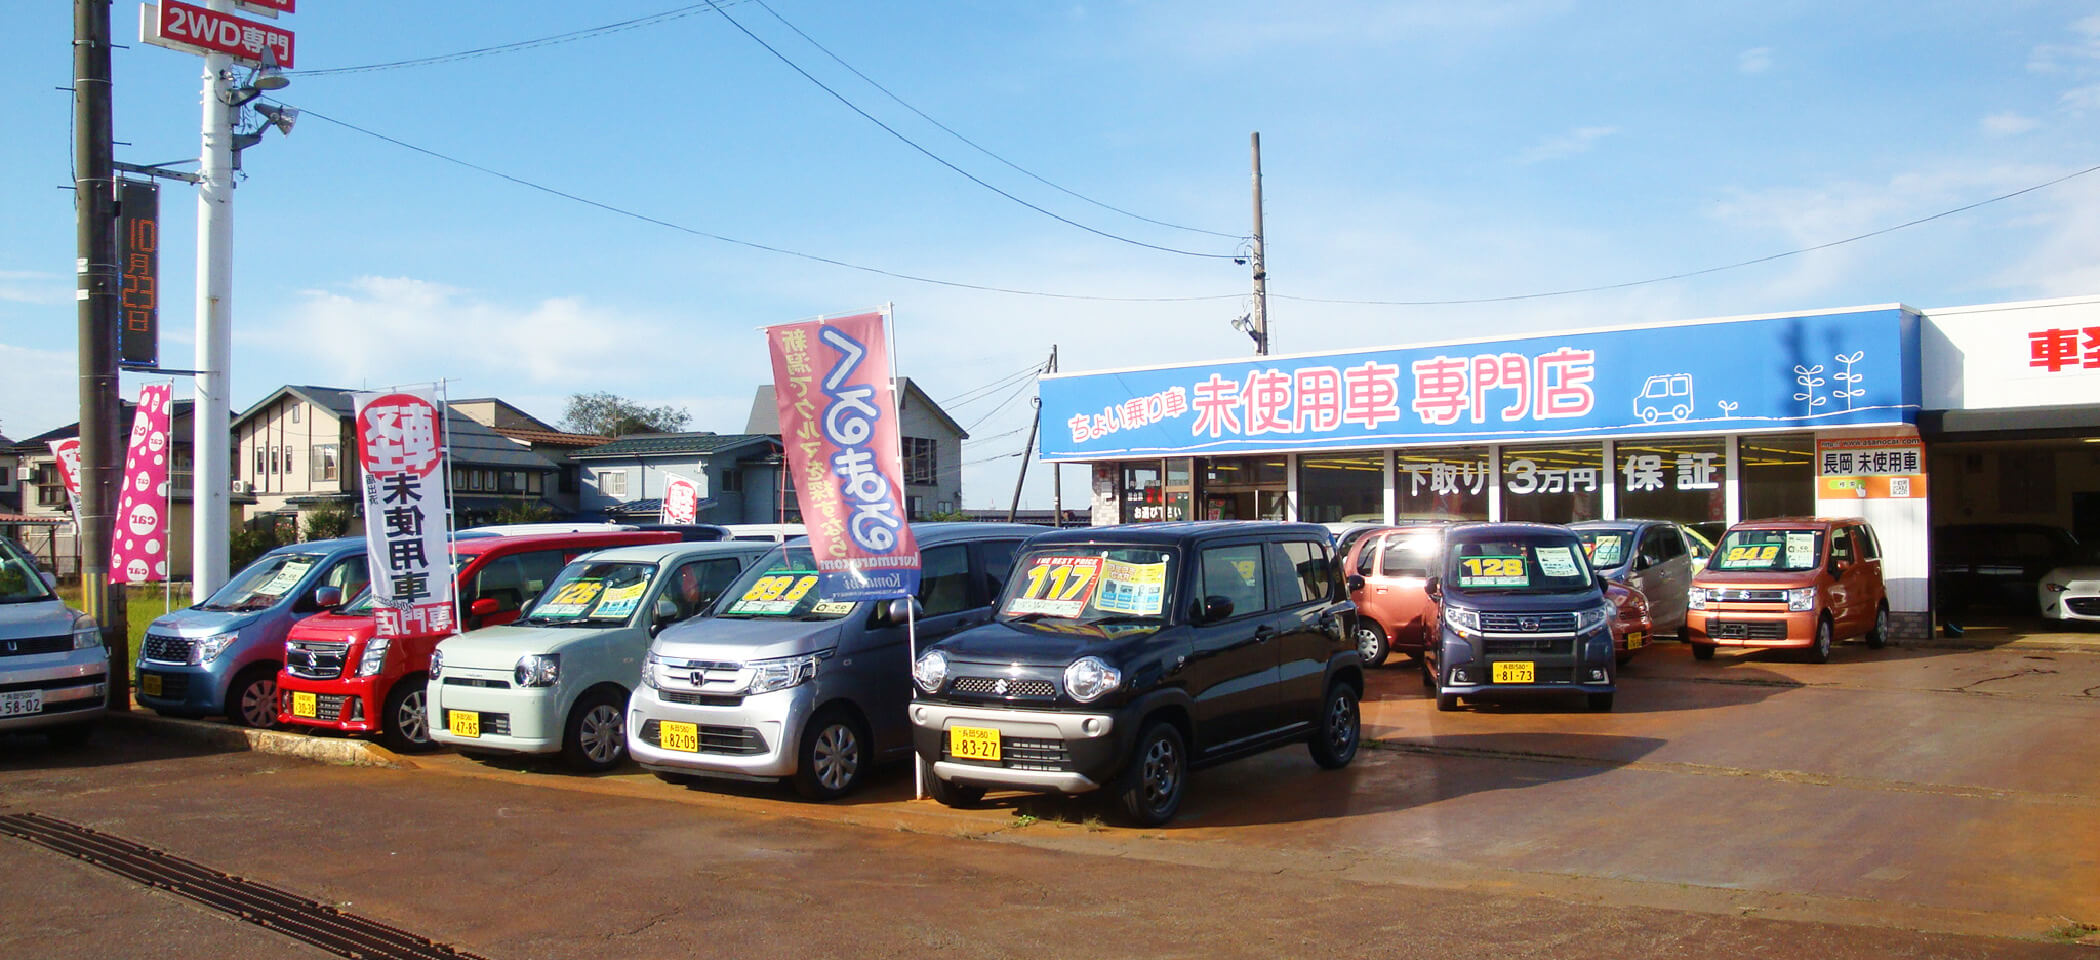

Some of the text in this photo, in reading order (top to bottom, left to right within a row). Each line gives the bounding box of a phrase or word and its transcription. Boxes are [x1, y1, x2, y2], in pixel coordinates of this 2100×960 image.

[167, 7, 289, 61] 2WD専門
[1069, 347, 1594, 443] ちょい乗り車 未使用車 専門店
[1824, 451, 1918, 474] 長岡 未使用車
[1401, 460, 1485, 496] 下取り
[1508, 459, 1597, 494] 3万円
[1463, 558, 1524, 576] 128
[1022, 564, 1098, 601] 117
[1502, 671, 1533, 681] 81-73
[5, 699, 40, 714] 58-02
[961, 739, 997, 757] 83-27
